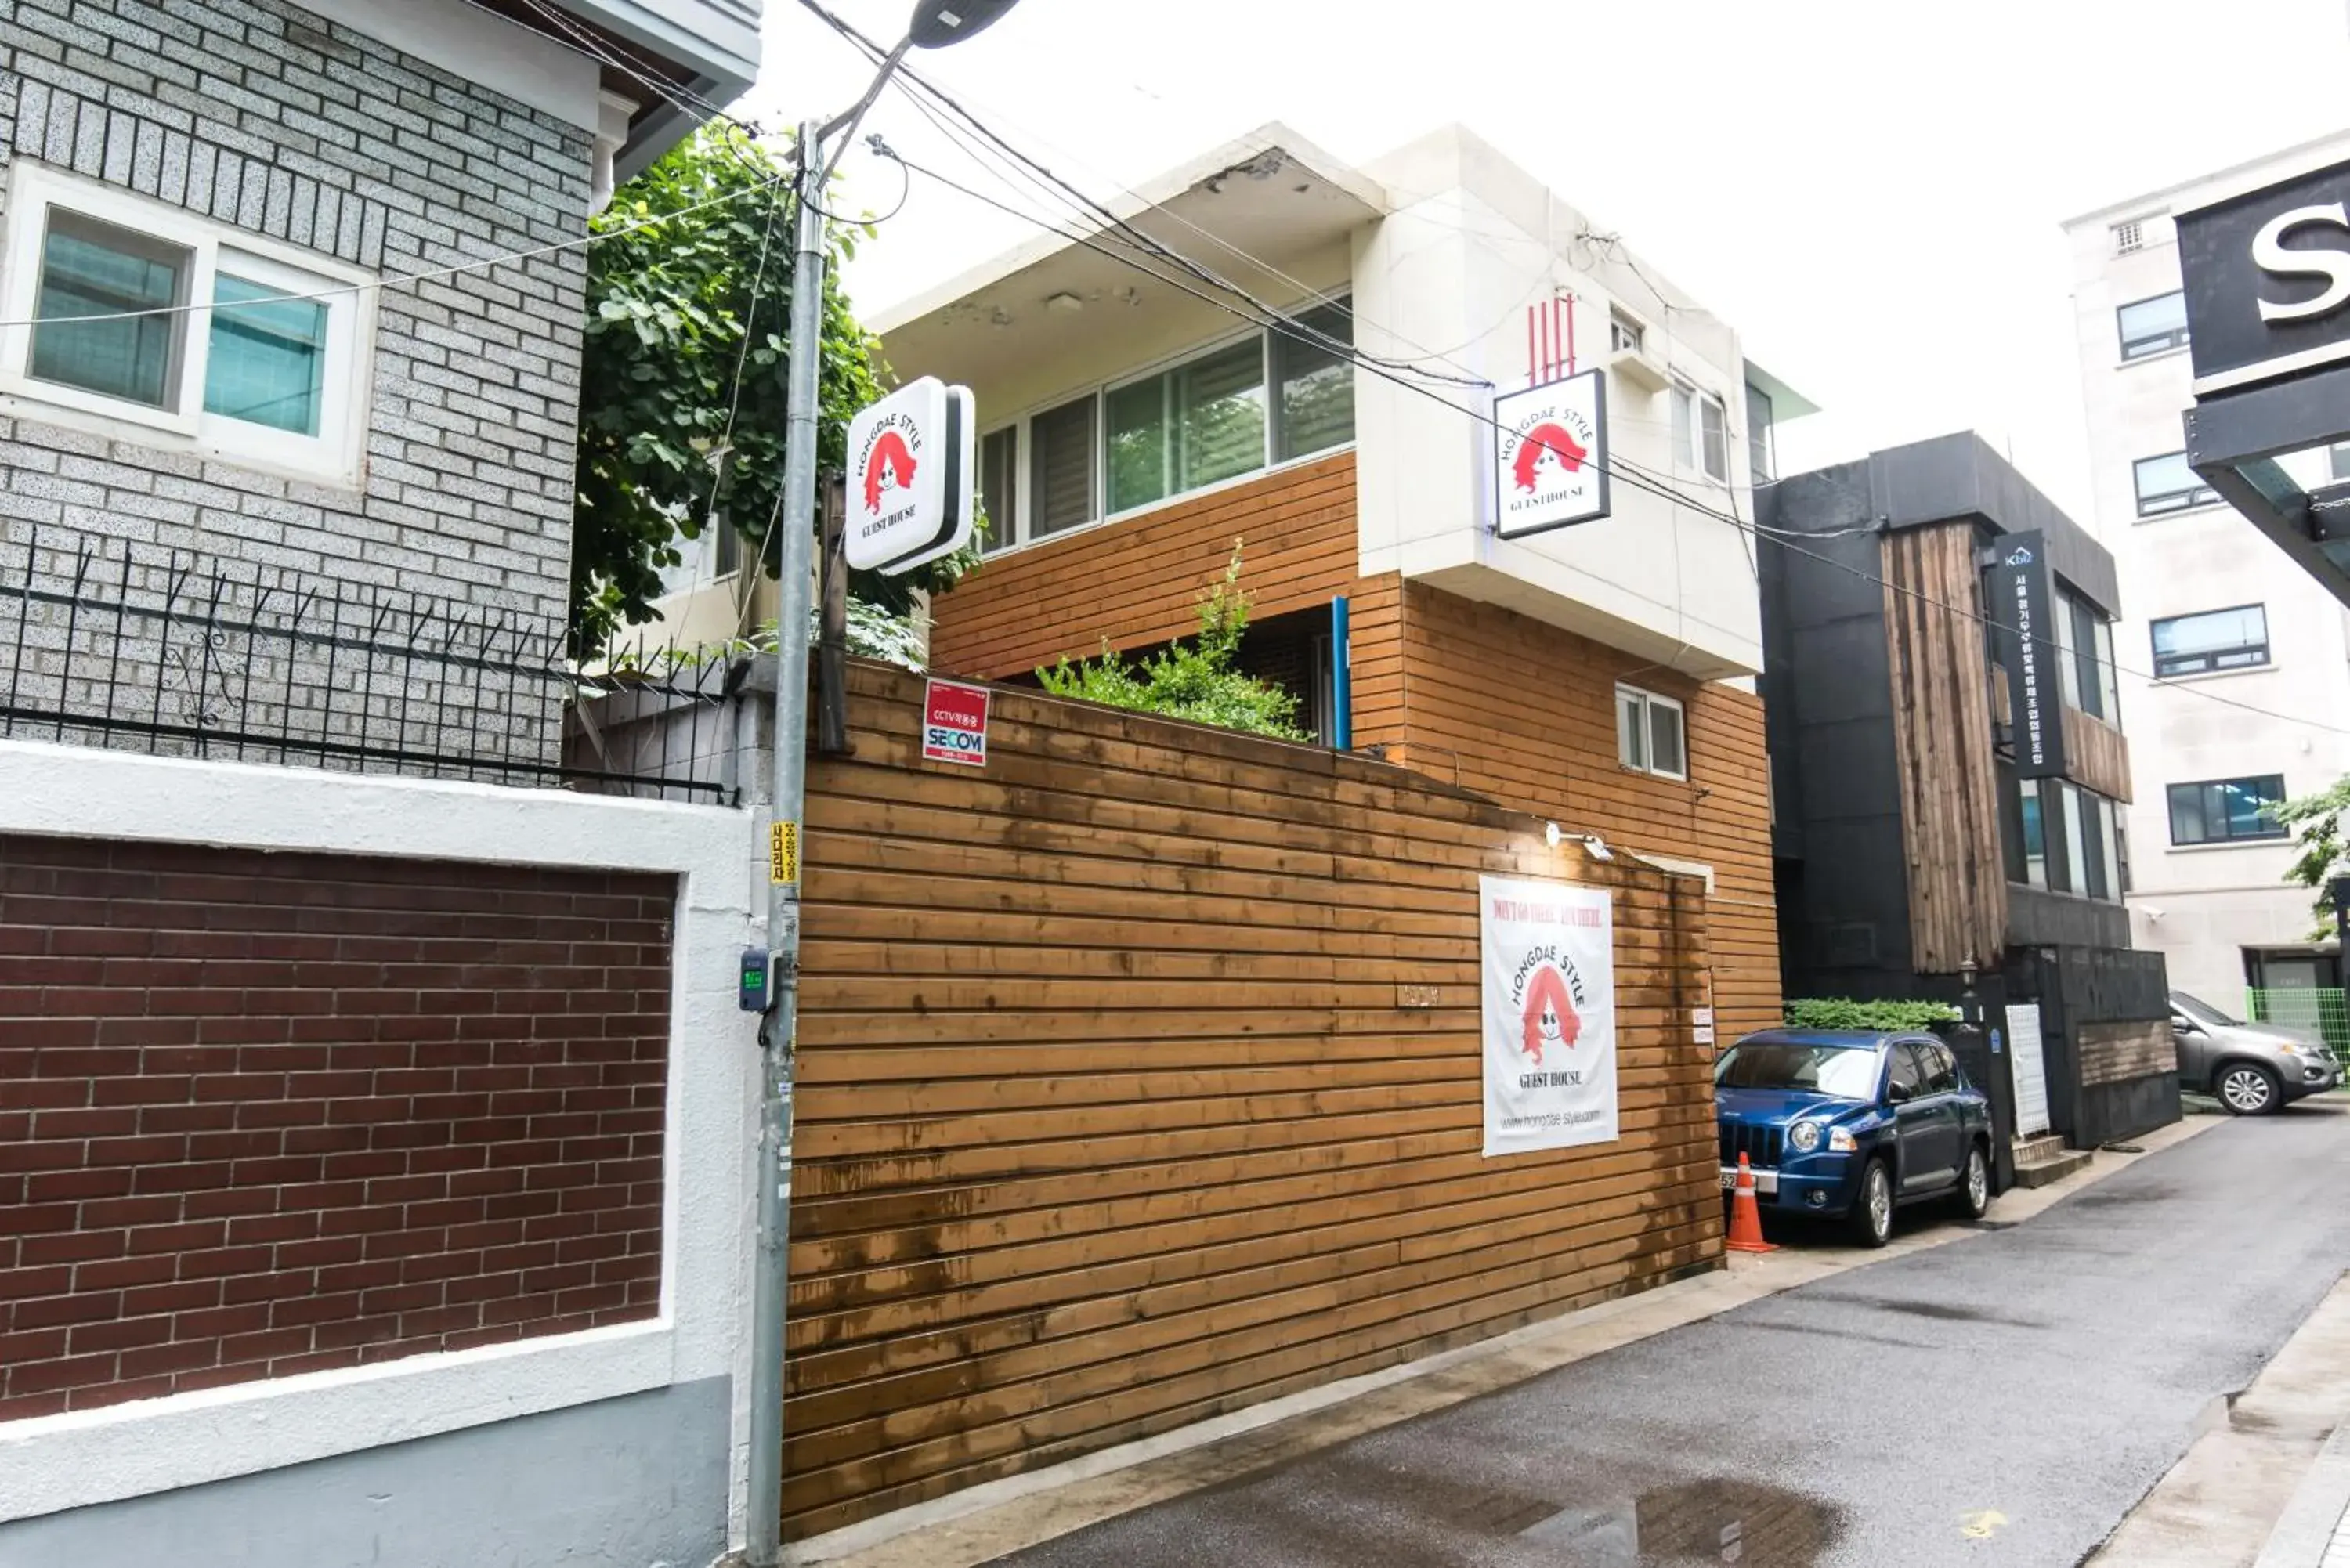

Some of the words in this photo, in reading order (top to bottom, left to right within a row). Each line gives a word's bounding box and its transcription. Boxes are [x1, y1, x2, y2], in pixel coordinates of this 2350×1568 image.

[858, 413, 898, 477] HONGDAE
[899, 414, 922, 452] STYLE
[1501, 406, 1556, 461] HONGDAE
[1562, 408, 1593, 442] STYLE
[928, 728, 982, 752] SECOM
[1512, 945, 1557, 1006] HONGDAE
[1560, 955, 1585, 1009] STYLE
[1519, 1072, 1549, 1089] GUEST
[1550, 1071, 1582, 1087] HOUSE
